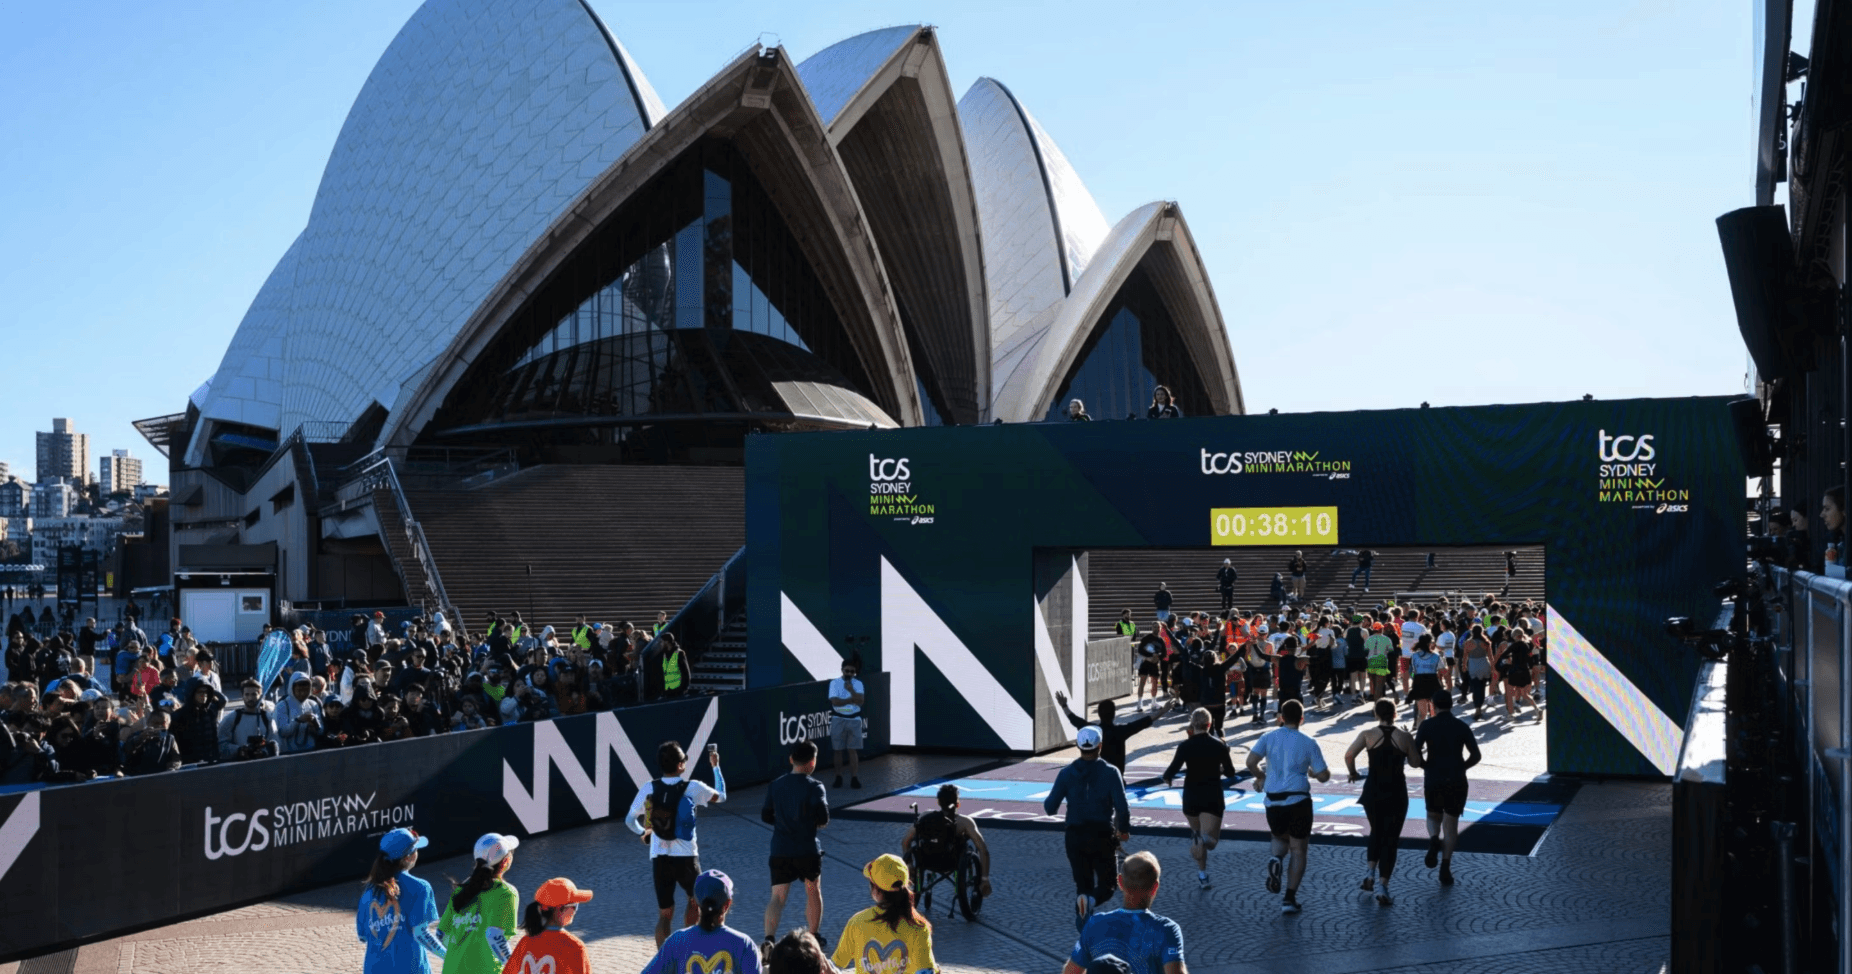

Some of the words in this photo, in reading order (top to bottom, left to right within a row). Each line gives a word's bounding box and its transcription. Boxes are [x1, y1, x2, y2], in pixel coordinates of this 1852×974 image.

[1599, 429, 1655, 462] tcs
[1200, 448, 1243, 474] tcs
[1245, 451, 1293, 463] SYDNEY
[869, 453, 910, 481] tcs
[1245, 463, 1272, 473] MINI
[1275, 461, 1350, 473] MARATHON
[1600, 463, 1656, 478] SYDNEY
[870, 482, 911, 494] SYDNEY
[1600, 478, 1632, 489] MINI
[870, 495, 894, 505] MINI
[1600, 490, 1688, 502] MARATHON
[870, 504, 934, 515] MARATHON
[1216, 512, 1331, 537] 00:38:10
[780, 711, 807, 745] tcs
[807, 710, 832, 728] SYDNE
[273, 796, 343, 828] SYDNEY
[205, 806, 269, 860] tcs
[273, 827, 313, 848] MINI
[318, 804, 414, 839] MARATHON
